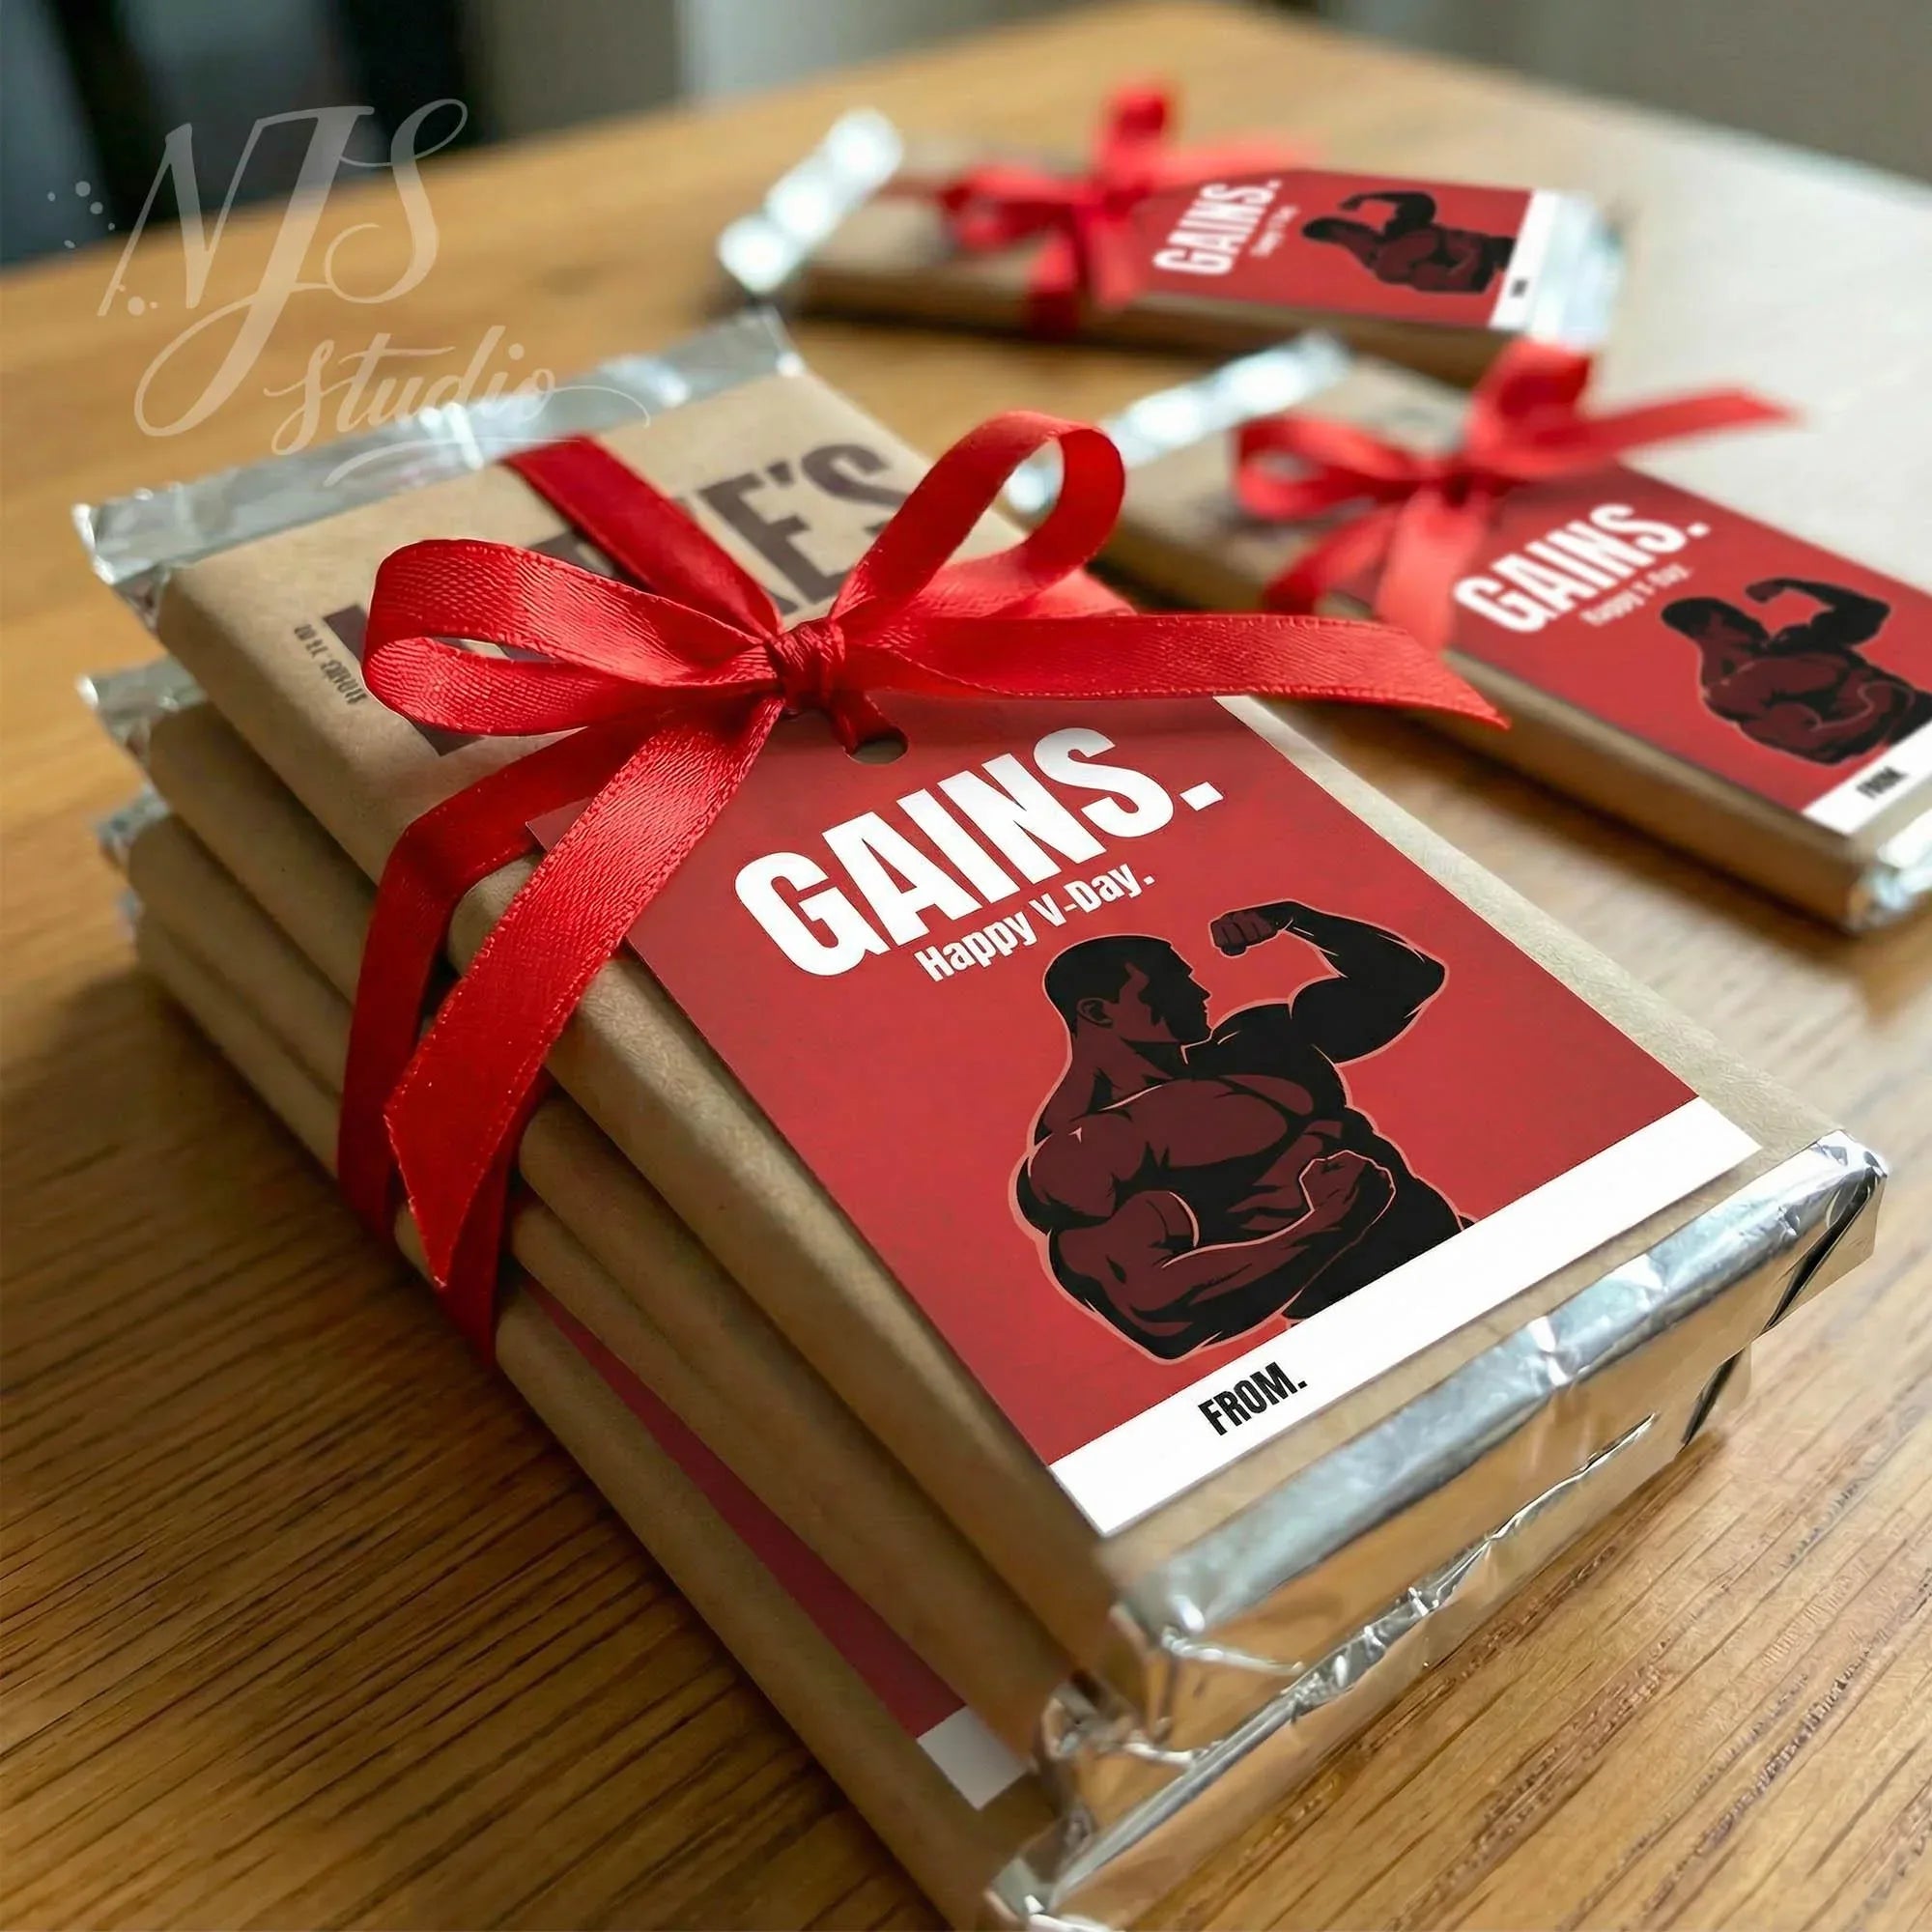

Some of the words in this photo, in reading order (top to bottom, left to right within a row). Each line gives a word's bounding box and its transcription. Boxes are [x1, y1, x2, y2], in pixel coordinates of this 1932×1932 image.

[1152, 180, 1283, 276] GAINS.
[1454, 502, 1710, 633] GAINS.
[734, 727, 1224, 976] GAINS.
[915, 913, 1037, 982] Happy
[1028, 863, 1155, 926] V-Day.
[1198, 1361, 1308, 1436] FROM.
